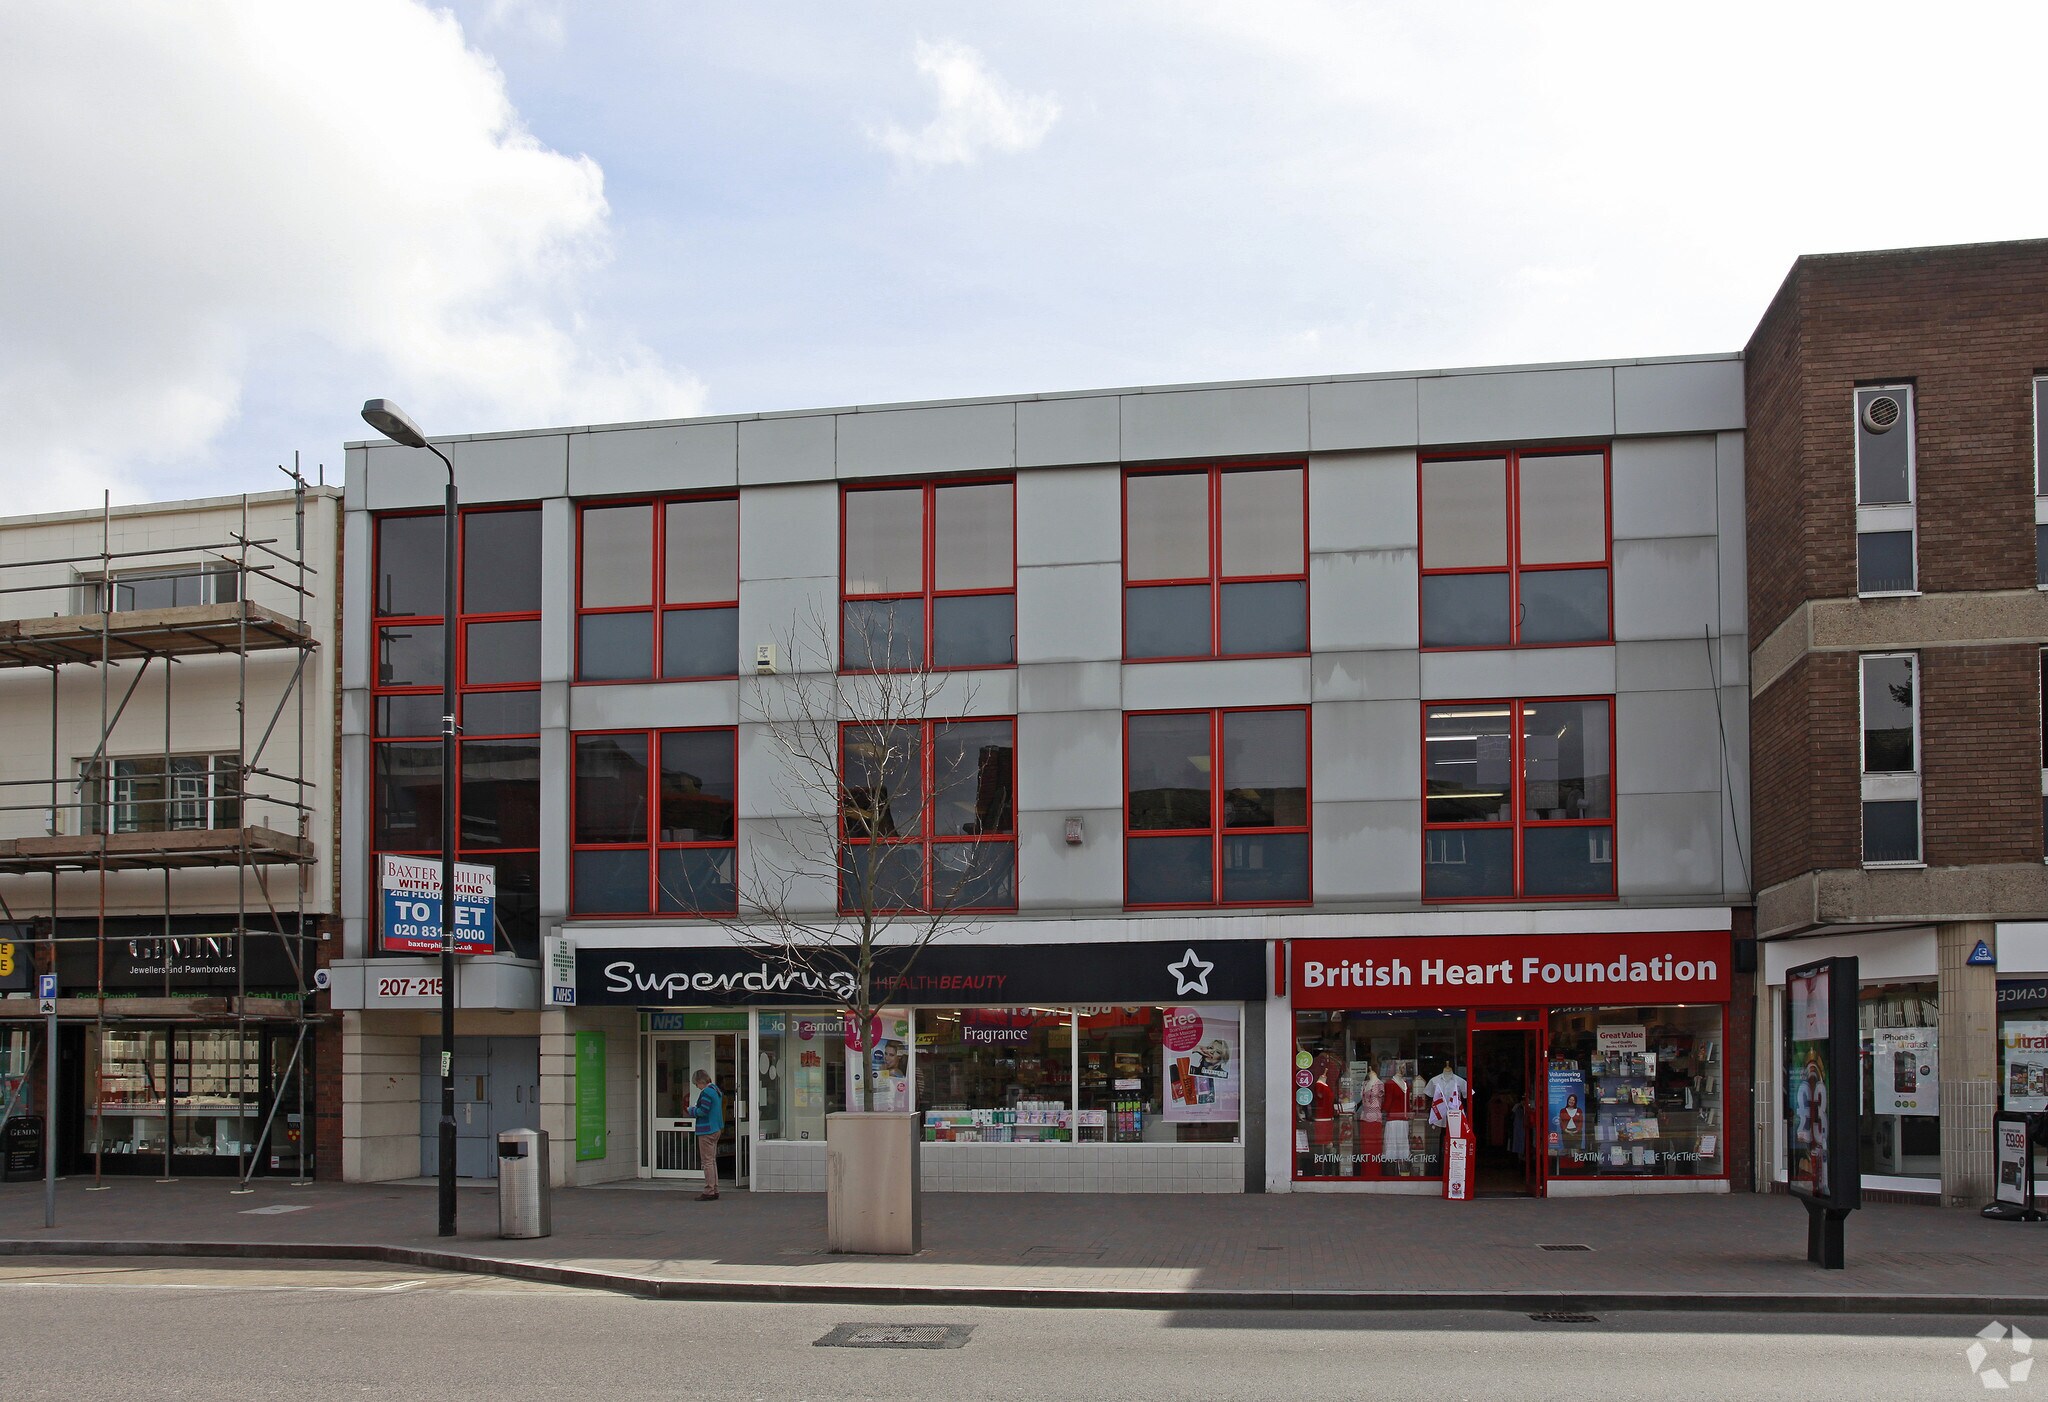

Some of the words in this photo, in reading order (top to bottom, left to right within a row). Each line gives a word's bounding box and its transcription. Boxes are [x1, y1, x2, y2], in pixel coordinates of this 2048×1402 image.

[388, 862, 437, 880] BAXTER
[454, 871, 492, 885] HILIPS
[399, 879, 429, 890] WITH
[433, 883, 483, 894] PKING
[390, 889, 409, 897] 2nd
[453, 894, 490, 904] FFICES
[395, 901, 431, 922] TO
[394, 924, 418, 936] 020
[421, 926, 450, 937] 831
[456, 929, 485, 940] 9000
[129, 965, 167, 975] Jewellers
[185, 964, 237, 974] Pawnbrokers
[1303, 958, 1412, 987] British
[1421, 958, 1514, 986] Heart
[1522, 953, 1717, 984] Foundation
[43, 977, 55, 997] P
[603, 961, 861, 999] Superdrug
[555, 988, 573, 1002] NHS
[653, 1015, 683, 1029] NHS
[1163, 1013, 1197, 1028] Free
[963, 1026, 1028, 1043] Fragrance
[1621, 1031, 1643, 1039] Value
[1882, 1033, 1908, 1041] iPhone
[1299, 1076, 1309, 1085] £4
[10, 1128, 39, 1136] GEMINI
[2005, 1132, 2025, 1149] £9.99
[1313, 1153, 1342, 1164] BEATING
[1347, 1153, 1370, 1163] HEART
[1574, 1152, 1604, 1163] BEATING
[1661, 1152, 1701, 1162] TOGETHER
